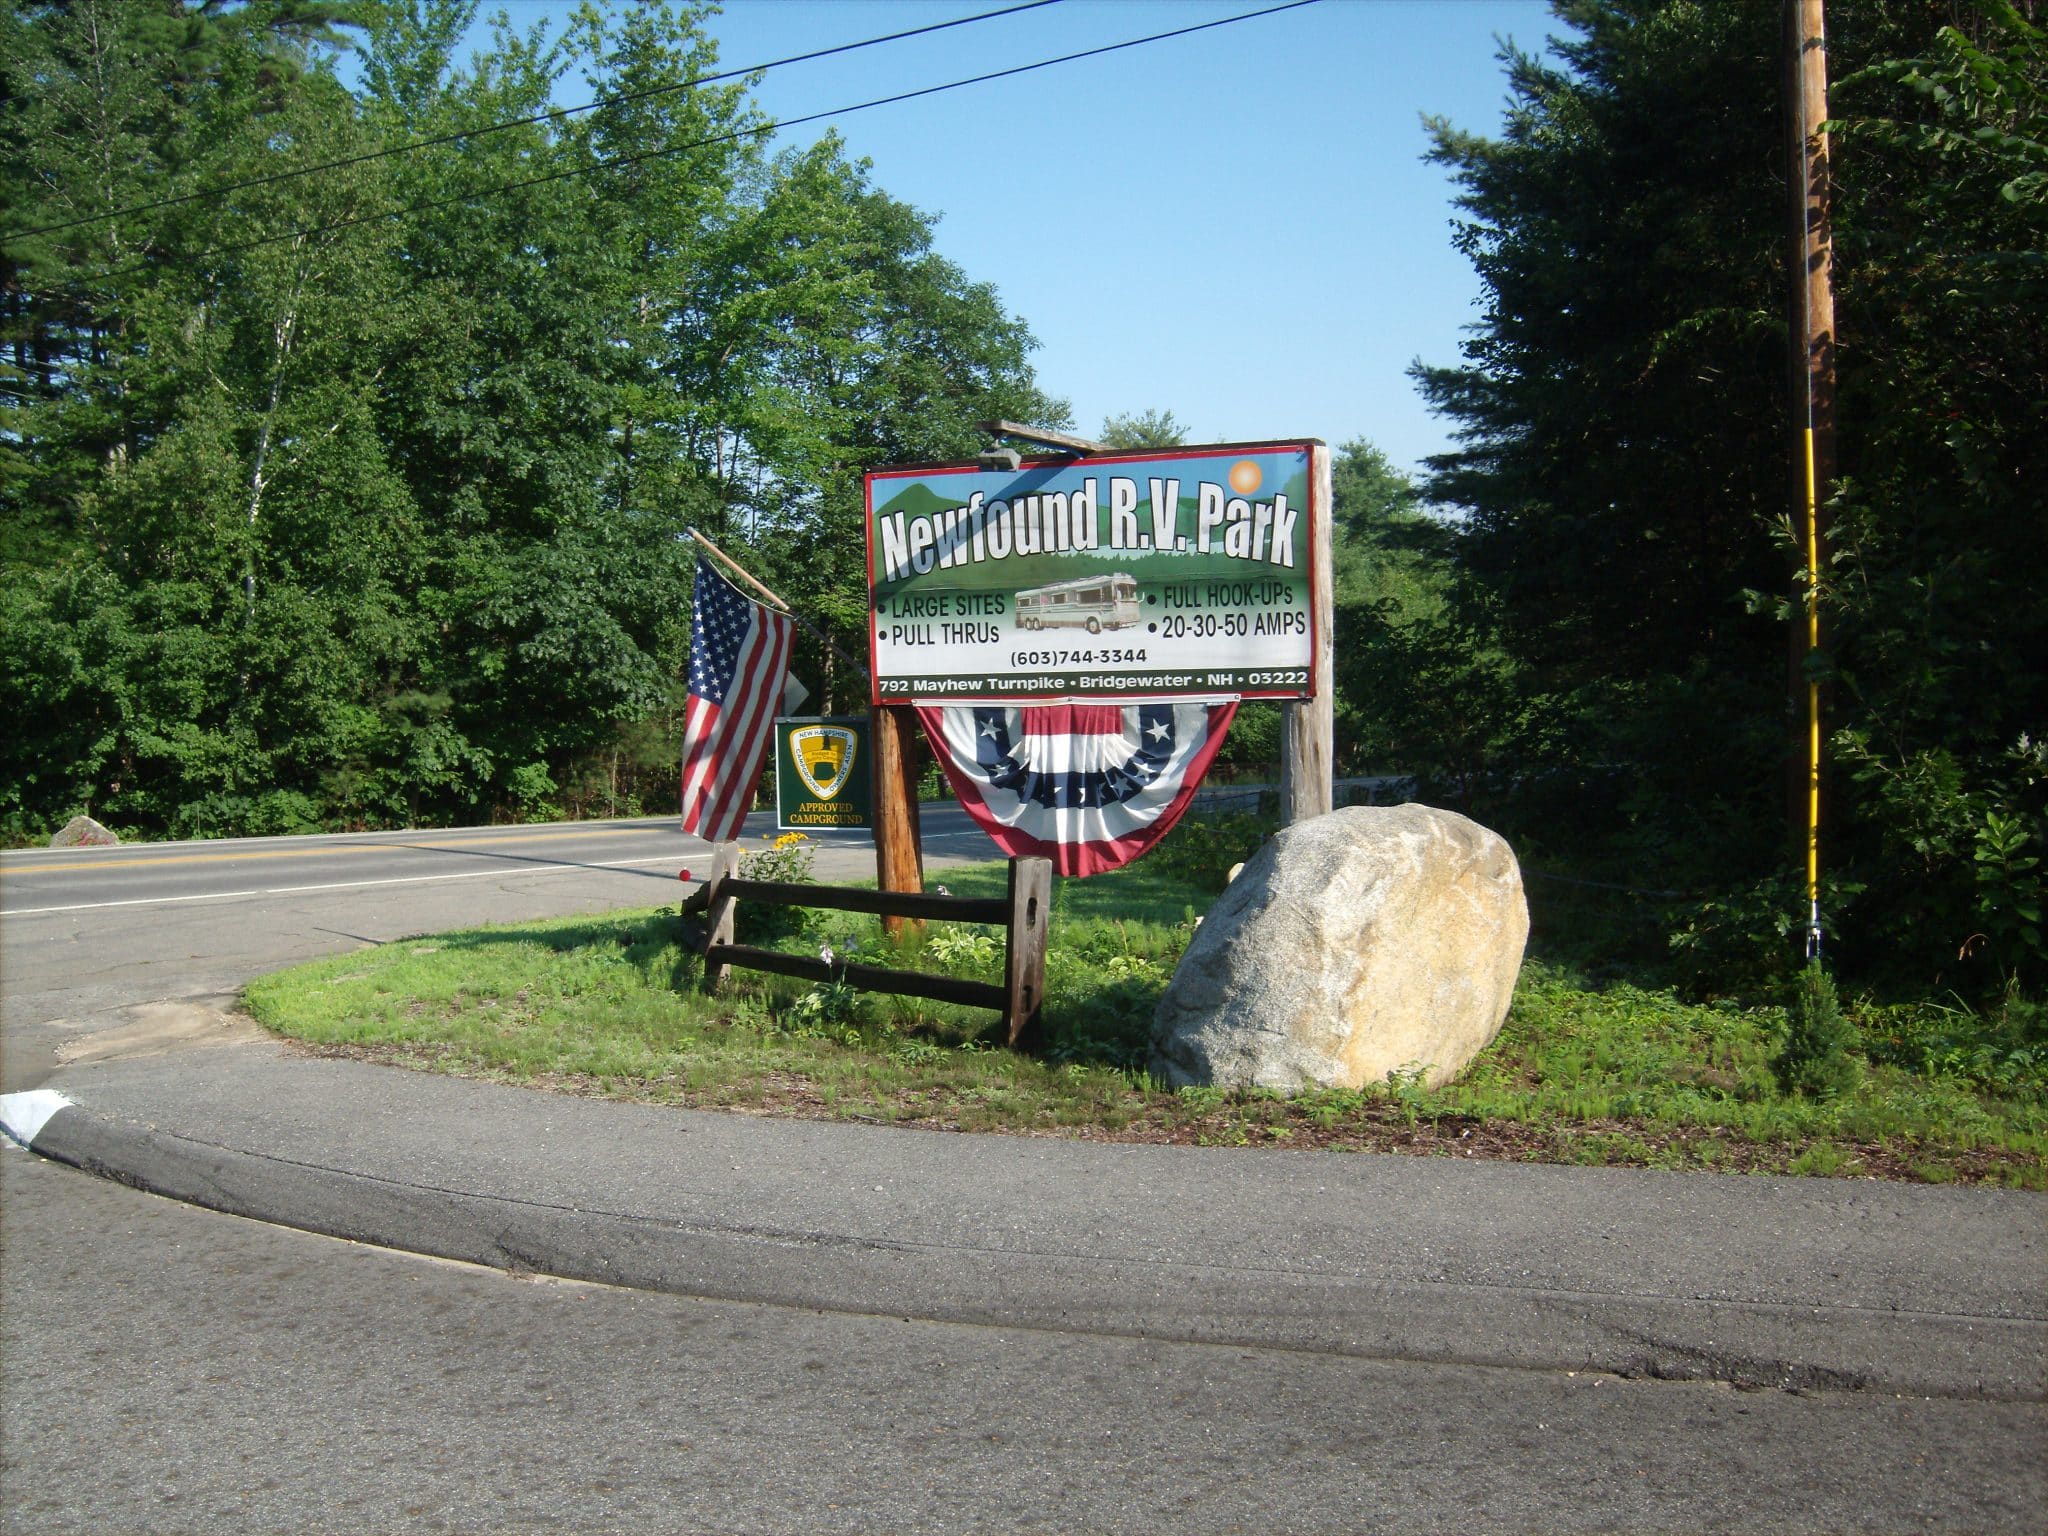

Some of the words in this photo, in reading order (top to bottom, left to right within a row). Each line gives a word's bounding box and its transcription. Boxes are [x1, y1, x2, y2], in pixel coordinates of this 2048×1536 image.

[880, 477, 1098, 582] Newfound
[1110, 477, 1186, 552] R.V.
[1197, 481, 1298, 568] Park
[892, 596, 950, 619] LARGE
[956, 593, 1005, 615] SITES
[1164, 586, 1202, 609] FULL
[1208, 582, 1293, 607] HOOK-UPs
[892, 624, 935, 646] PULL
[942, 621, 999, 644] THRUs
[1162, 613, 1247, 638] 20-30-50
[1254, 611, 1305, 636] AMPS
[1011, 648, 1147, 667] (603)744-3344
[879, 680, 909, 692] 792
[914, 678, 982, 694] Mayhew
[987, 676, 1064, 693] Turnpike
[1080, 674, 1191, 692] Bridgewater
[1208, 673, 1233, 686] NH
[1249, 671, 1307, 685] 03222
[815, 730, 848, 738] HAMPSHIRE
[790, 814, 862, 824] CAMPGROUND
[799, 803, 853, 812] APPROVED
